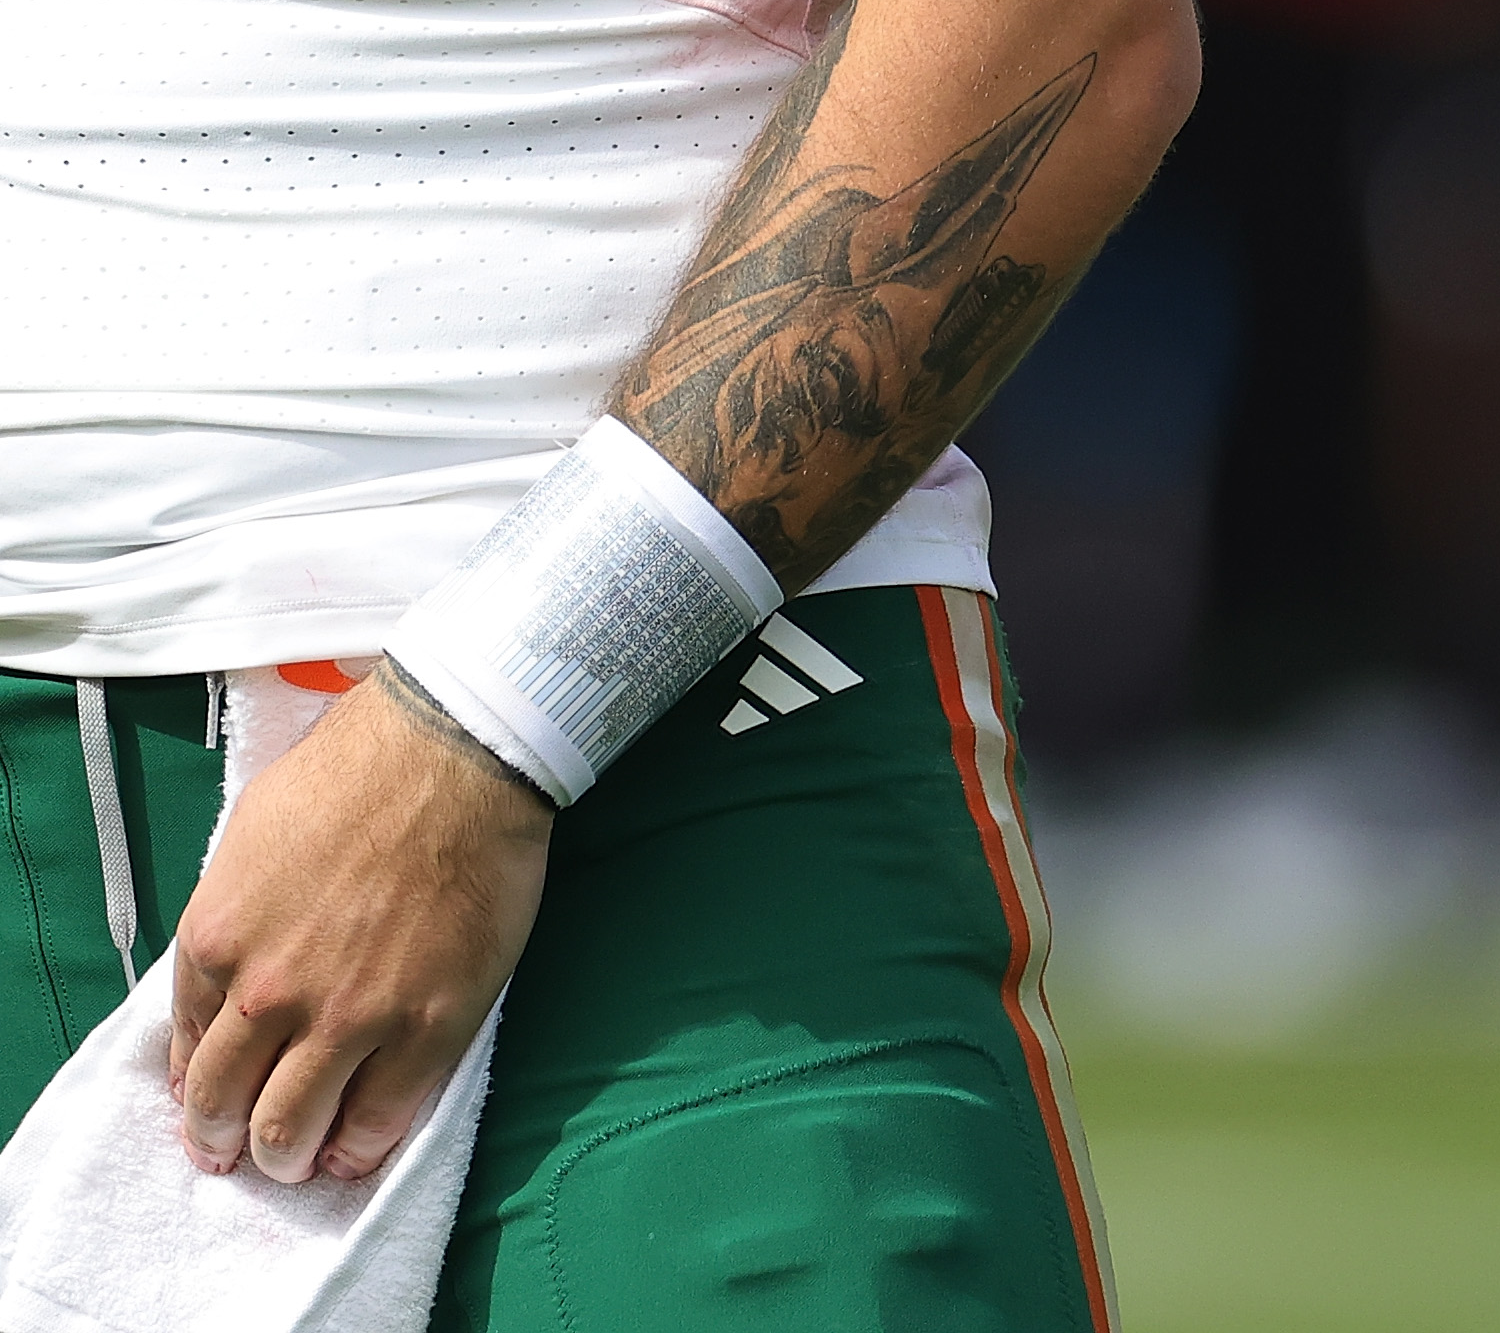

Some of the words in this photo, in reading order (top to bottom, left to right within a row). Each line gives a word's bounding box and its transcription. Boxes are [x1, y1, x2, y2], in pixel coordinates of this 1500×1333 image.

[651, 527, 664, 540] 25
[625, 538, 639, 552] TO
[643, 538, 653, 548] H
[666, 543, 679, 555] 23
[633, 545, 646, 559] TO
[637, 546, 661, 570] COCK
[629, 567, 640, 577] IT
[644, 553, 668, 577] COCK
[619, 574, 632, 587] LT
[636, 574, 647, 585] IT
[652, 561, 676, 585] LOOP
[658, 568, 683, 593] ROOK
[626, 582, 639, 596] RT
[640, 581, 655, 596] ON
[681, 583, 696, 598] LIZ
[646, 590, 661, 605] ON
[566, 601, 591, 626] PIVOT
[573, 614, 592, 633] CUT
[579, 622, 599, 642] CUT
[631, 633, 647, 648] GO
[531, 636, 556, 661] HOOK
